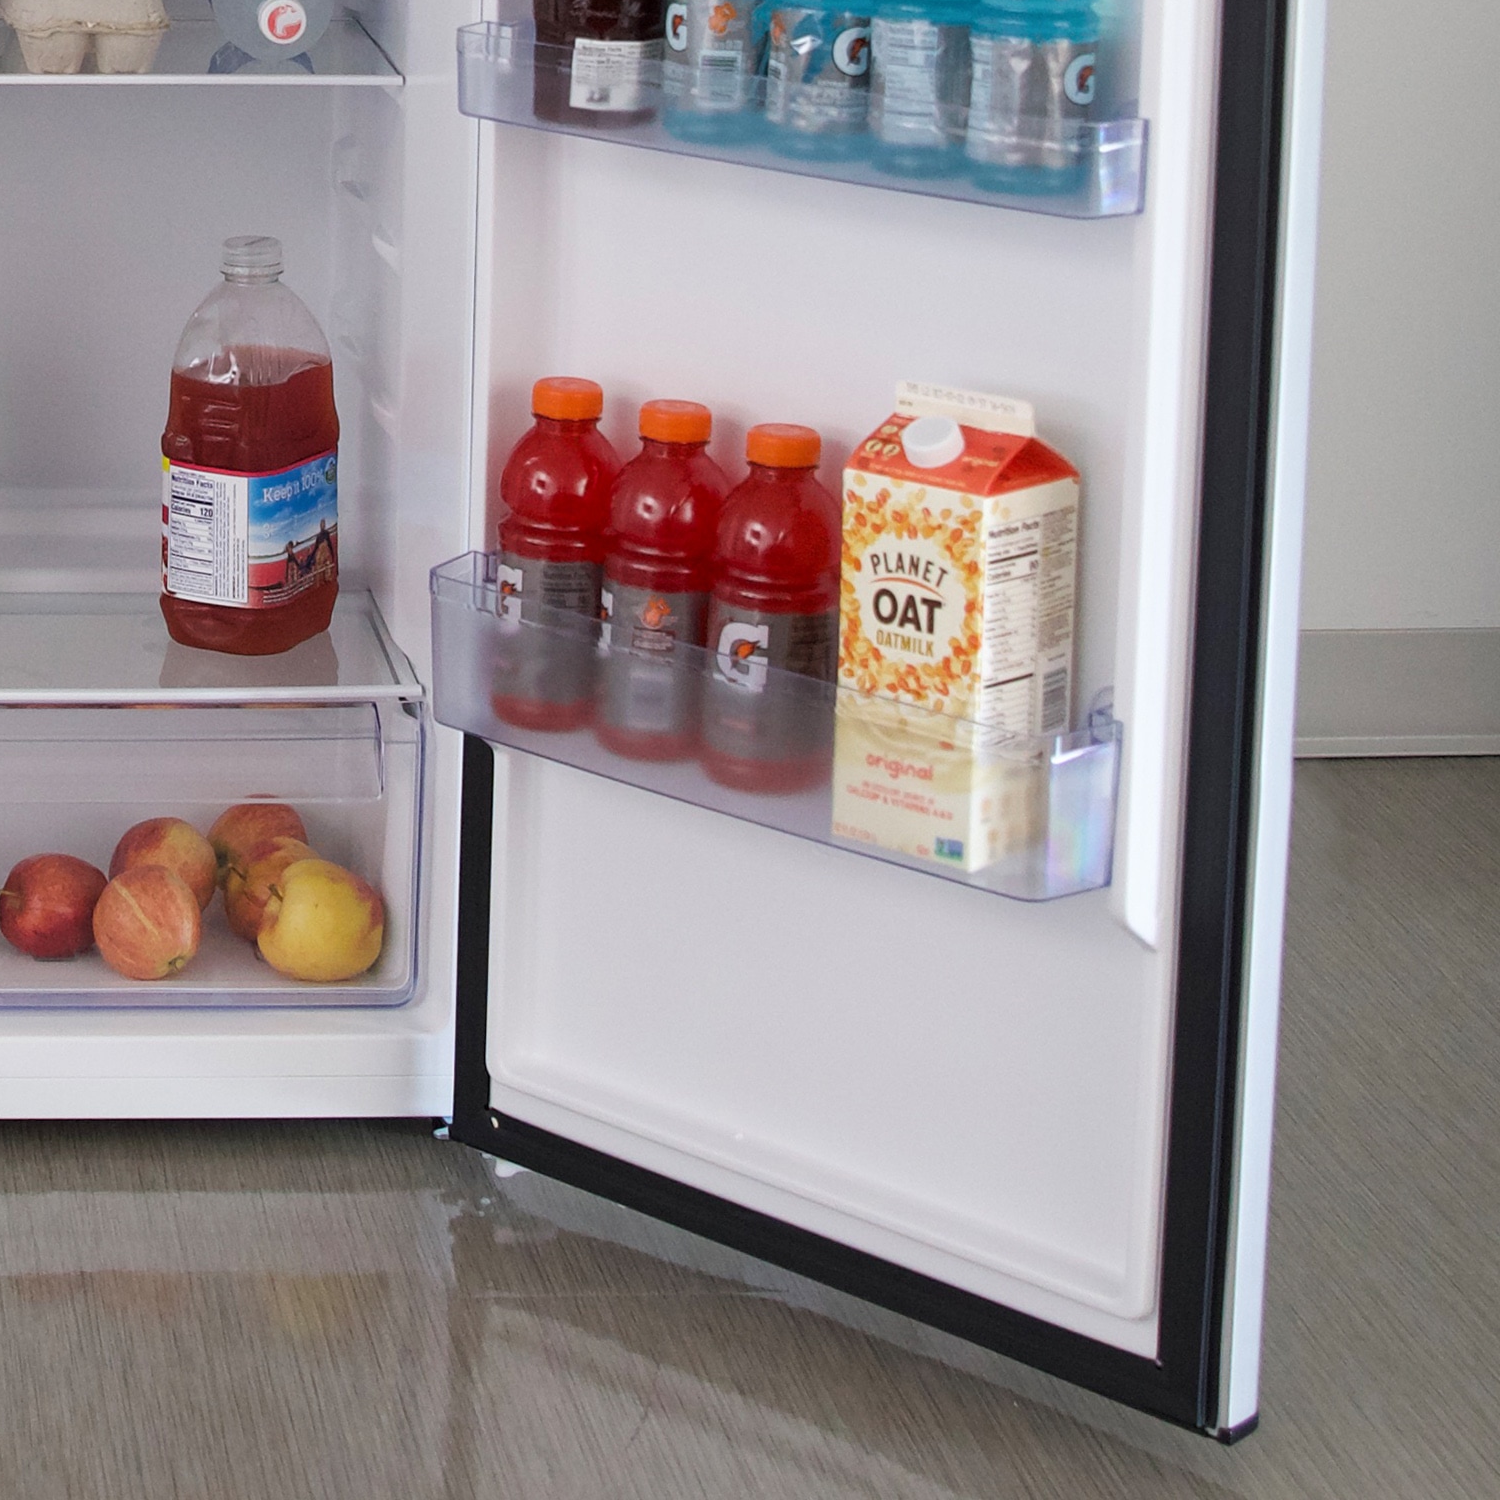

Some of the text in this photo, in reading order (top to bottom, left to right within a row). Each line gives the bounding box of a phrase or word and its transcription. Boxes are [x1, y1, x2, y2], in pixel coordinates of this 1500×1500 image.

[666, 3, 688, 51] G
[832, 26, 870, 77] G
[1063, 53, 1096, 105] G
[171, 474, 195, 486] Nutrition
[196, 480, 214, 489] Facts
[263, 484, 292, 503] Keep
[302, 469, 324, 491] 100%
[171, 503, 214, 518] Calories 120
[988, 526, 1020, 539] Nutrition
[870, 552, 949, 588] PLANET
[873, 588, 943, 635] OAT
[716, 622, 769, 691] G
[876, 629, 935, 658] OATMILK
[865, 753, 934, 780] original
